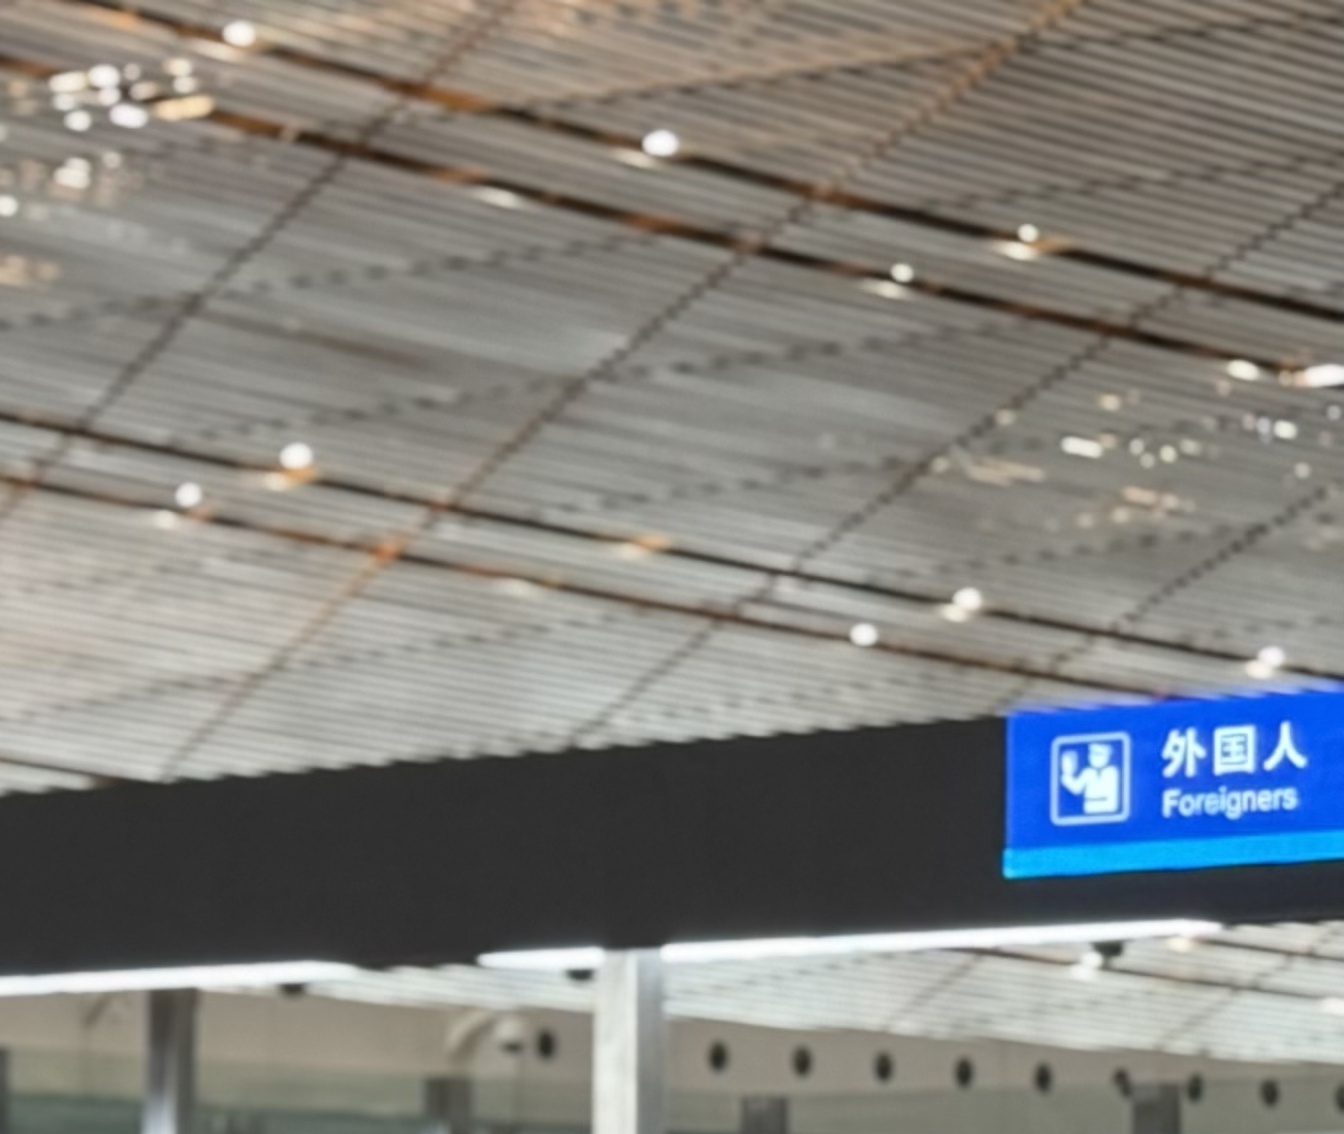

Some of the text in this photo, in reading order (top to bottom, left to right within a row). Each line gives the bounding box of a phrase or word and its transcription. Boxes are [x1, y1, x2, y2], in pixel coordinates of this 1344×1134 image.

[1161, 720, 1308, 778] 外国人
[1162, 786, 1300, 820] Foreigners
